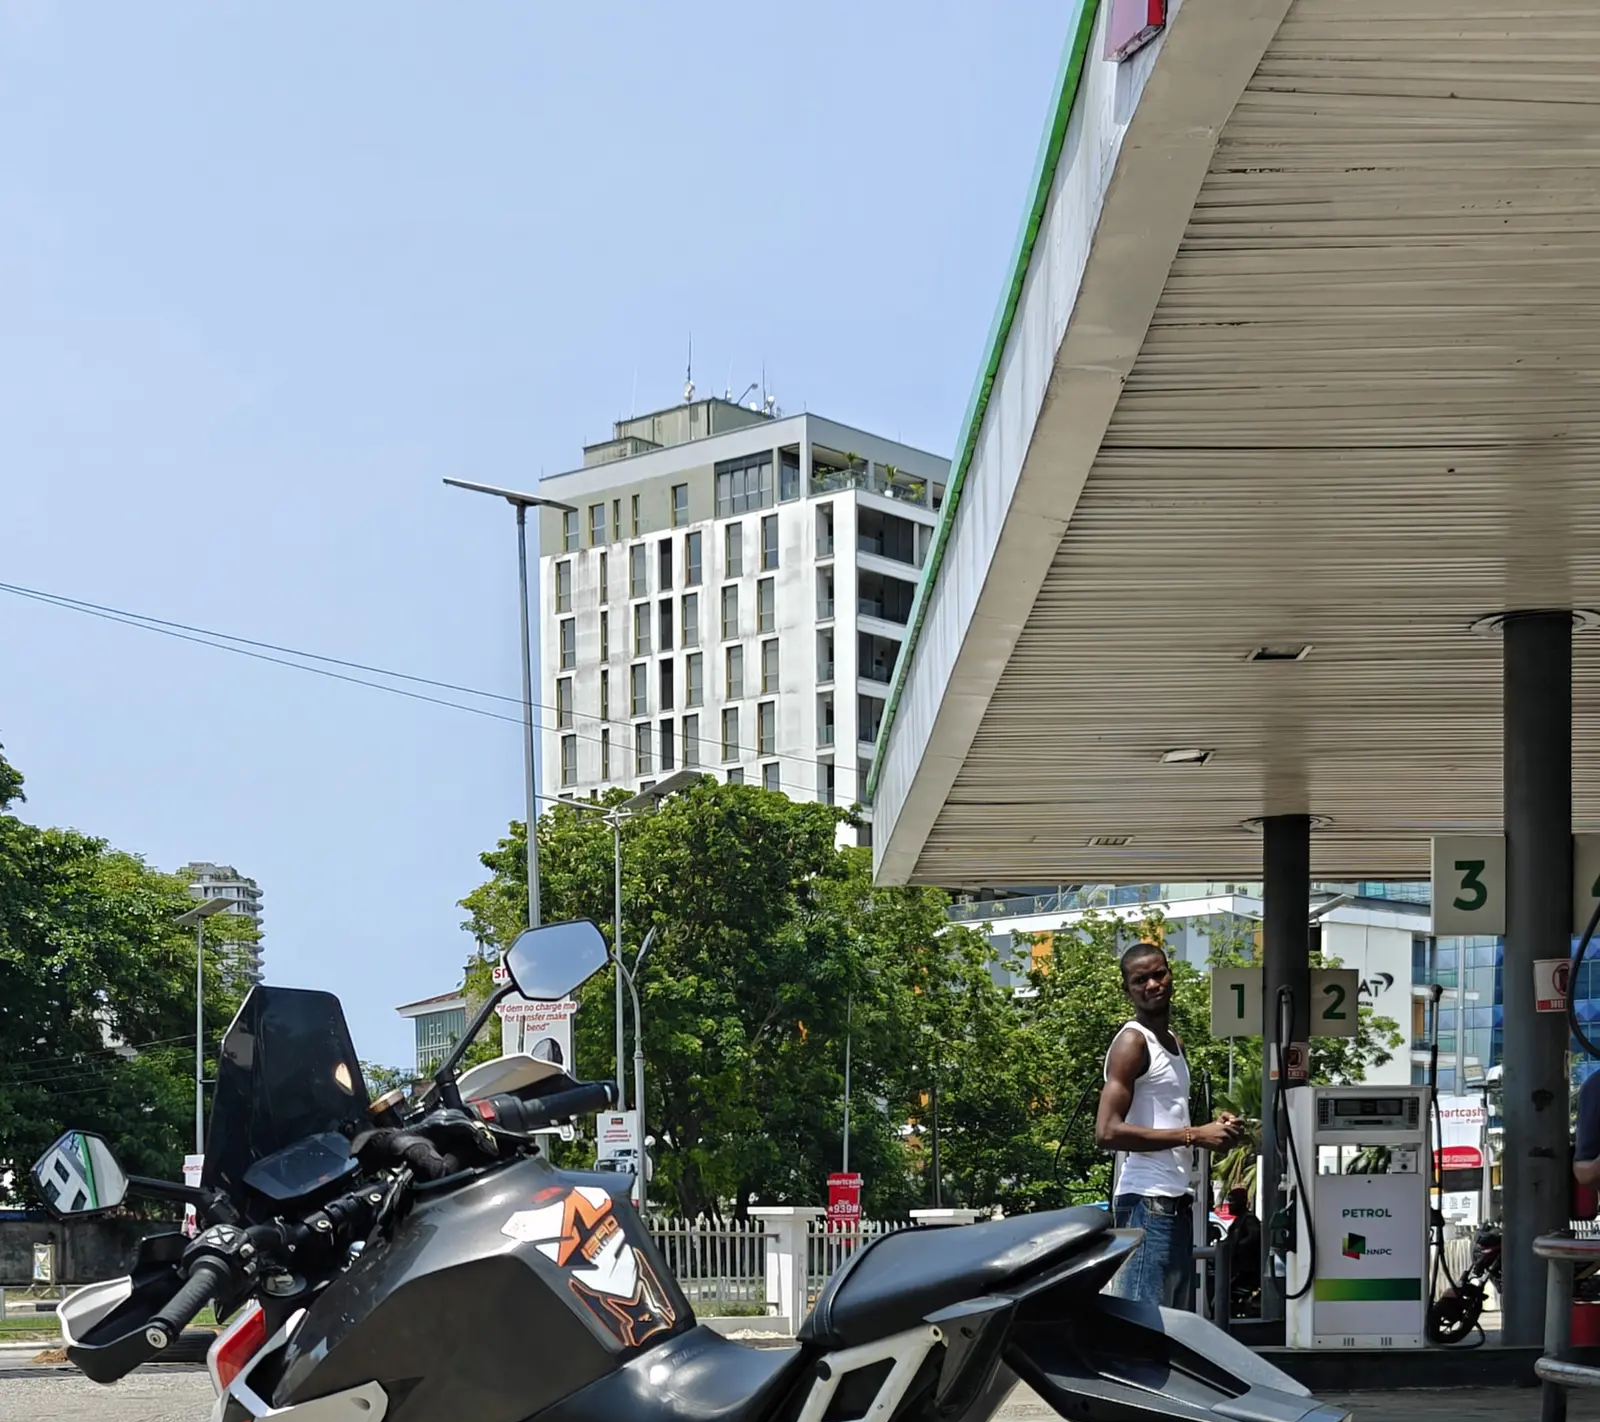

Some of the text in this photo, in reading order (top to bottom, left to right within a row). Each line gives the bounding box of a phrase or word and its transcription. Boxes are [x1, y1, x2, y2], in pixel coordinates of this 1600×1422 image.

[1453, 860, 1488, 911] 3
[524, 1003, 535, 1011] no
[535, 1002, 562, 1012] charge
[1230, 984, 1245, 1019] 1
[1322, 984, 1347, 1020] 2
[504, 1014, 516, 1023] for
[546, 1012, 568, 1020] make
[1342, 1208, 1393, 1218] PETROL
